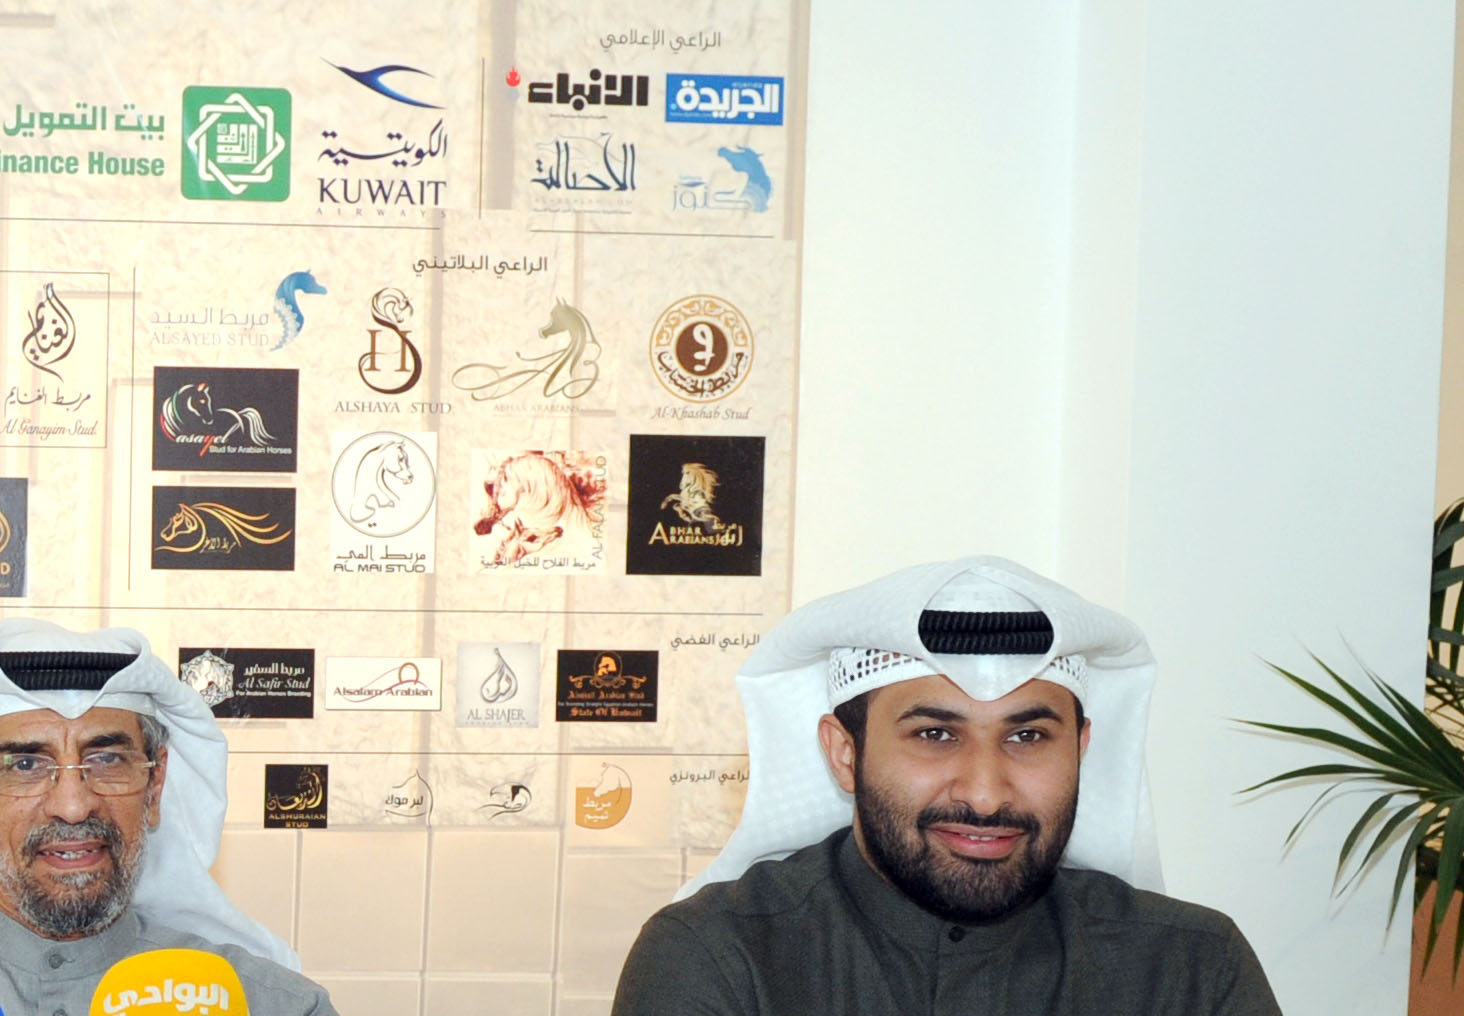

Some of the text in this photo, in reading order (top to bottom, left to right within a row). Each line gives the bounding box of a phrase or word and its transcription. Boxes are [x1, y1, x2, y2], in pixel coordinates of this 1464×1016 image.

[600, 29, 721, 51] الراعي الإعلامي
[676, 80, 779, 119] الجريدة
[2, 103, 107, 138] التمويل
[116, 103, 165, 141] بيت
[317, 117, 448, 168] الكويتية
[88, 152, 165, 177] House
[317, 177, 448, 206] KUWAIT
[316, 208, 447, 218] AIRWAYS
[413, 254, 548, 278] الراعي البلاتيني
[150, 306, 270, 330] مربط السيد
[150, 331, 270, 347] ALSAYED STUD
[335, 401, 452, 414] ALSHAYA STUD
[209, 445, 293, 455] Stud for Arabian Horses
[385, 563, 426, 574] STUD
[670, 633, 760, 652] الراعي الفضي
[285, 676, 311, 689] Stud
[467, 708, 525, 723] AL SHAJER
